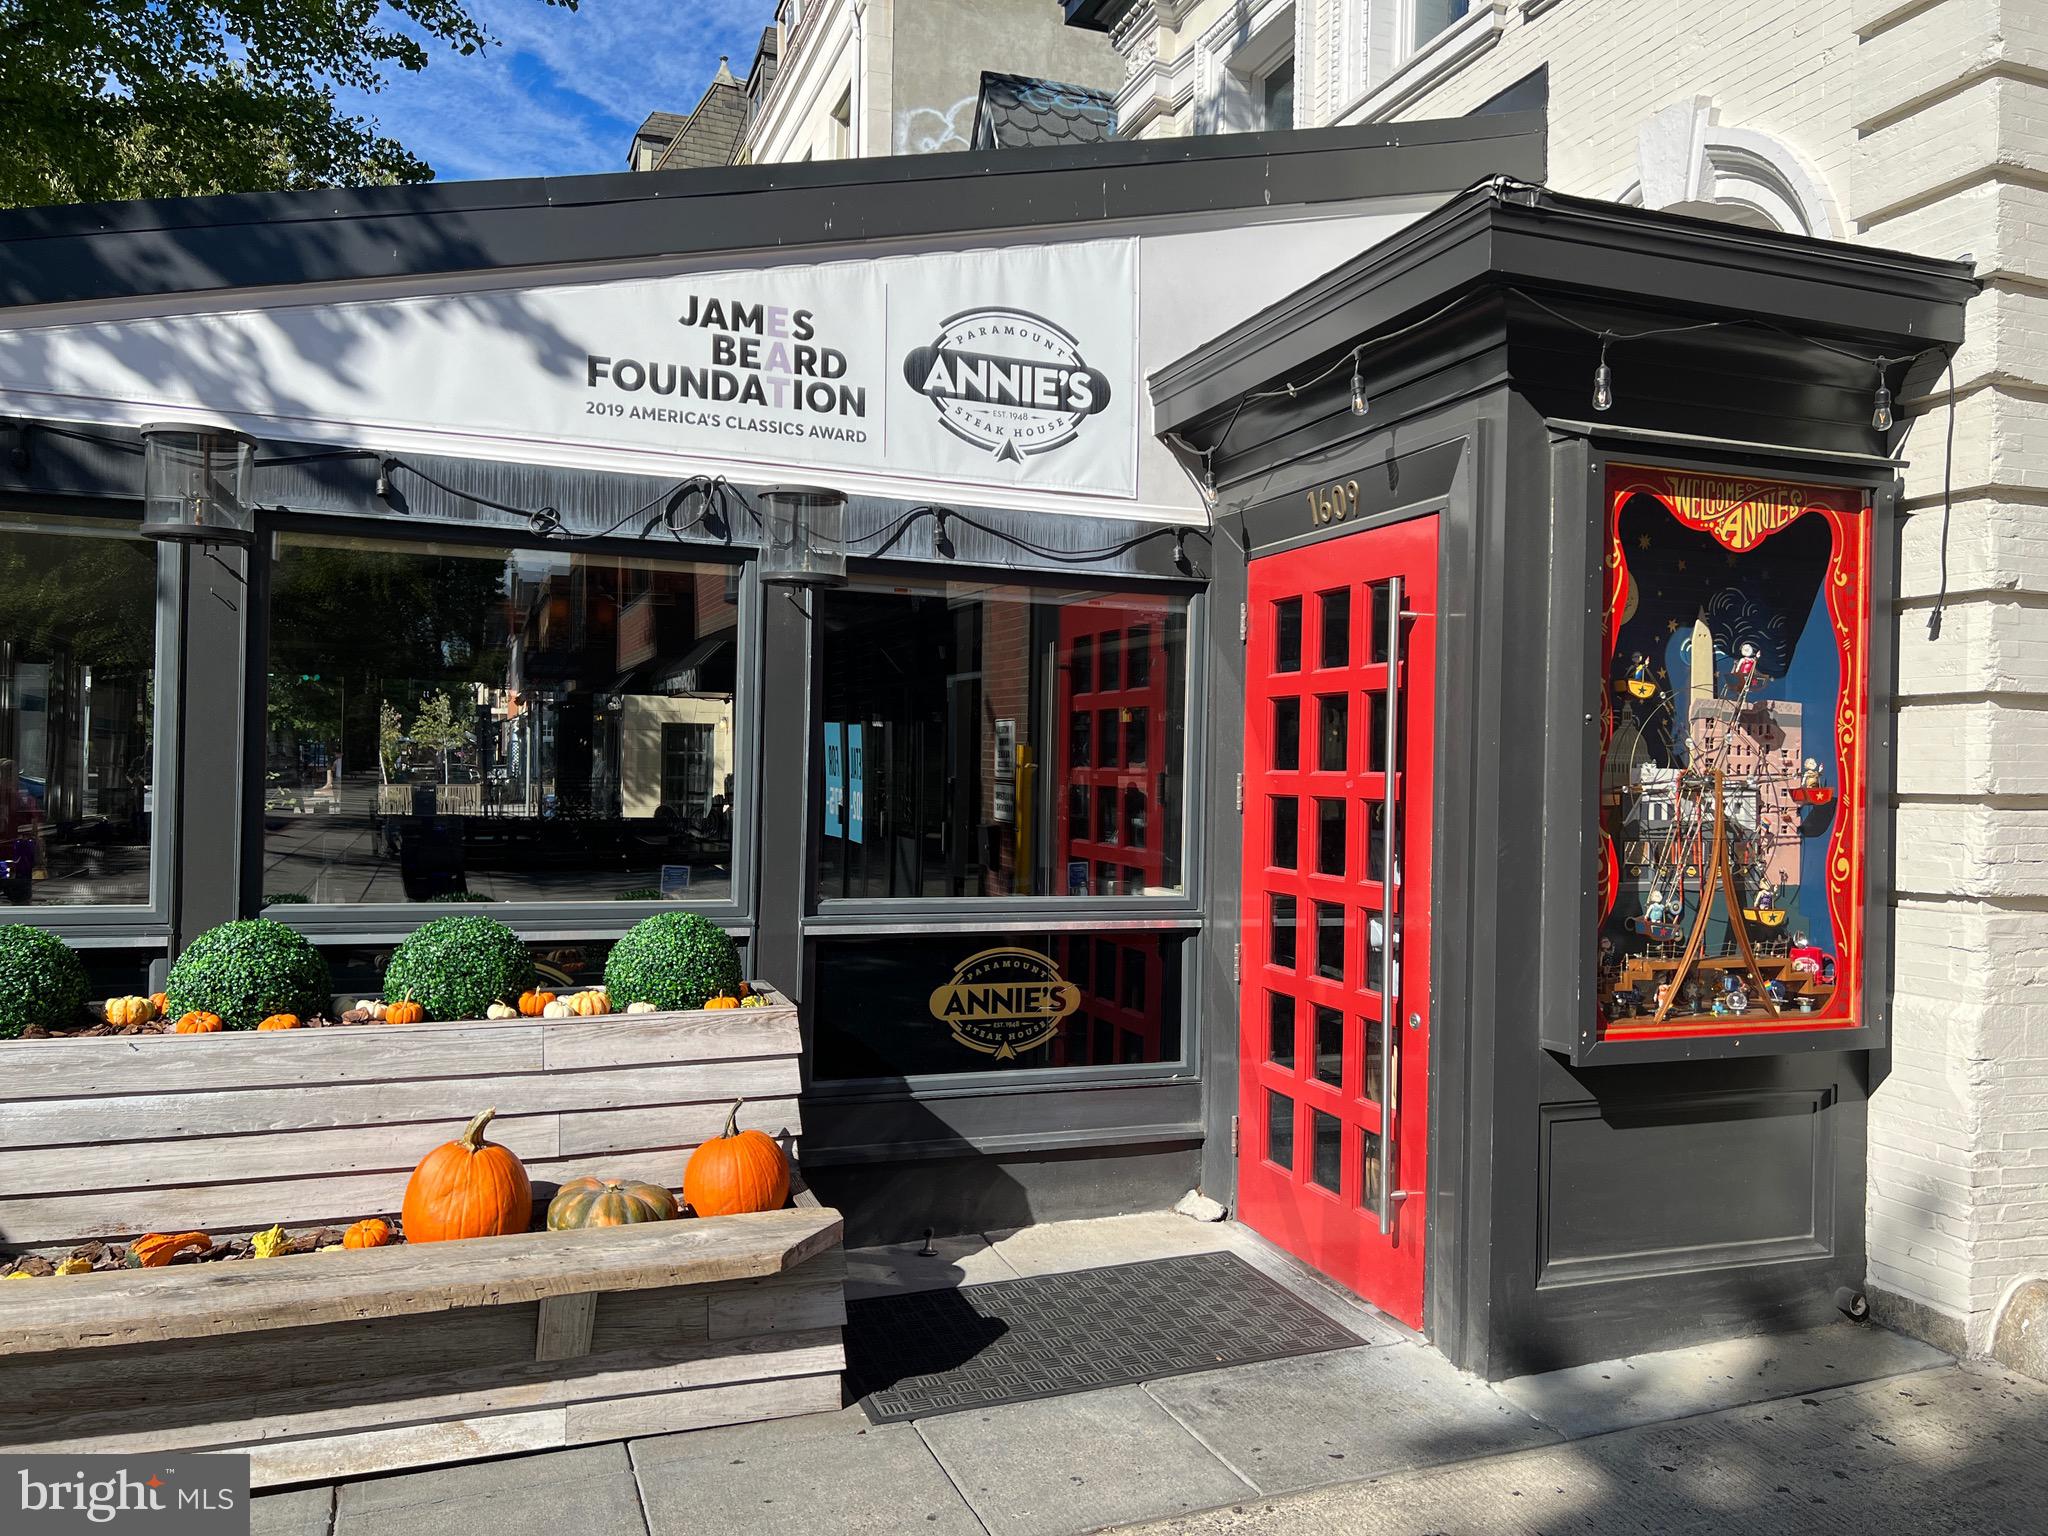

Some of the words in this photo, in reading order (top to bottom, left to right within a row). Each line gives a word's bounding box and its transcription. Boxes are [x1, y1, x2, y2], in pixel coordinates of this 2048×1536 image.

[678, 295, 815, 341] JAMES
[712, 333, 847, 379] BEARD
[956, 325, 1065, 358] PARAMOUNT
[587, 354, 866, 418] FOUNDATION
[922, 353, 1093, 409] ANNIE'S
[585, 401, 624, 417] 2019
[629, 405, 721, 427] AMERICA'S
[725, 415, 804, 437] CLASSICS
[808, 425, 867, 443] AWARD
[954, 406, 1004, 435] STEAK
[1014, 417, 1065, 438] HOUSE
[1009, 411, 1028, 421] 1948
[1306, 480, 1360, 525] 1609
[1664, 476, 1745, 520] WELCOME
[967, 960, 1047, 981] PARAMOUNT
[944, 986, 1067, 1016] ANNIE'S
[965, 1024, 1002, 1040] STEAK
[1008, 1021, 1046, 1040] HOUSE
